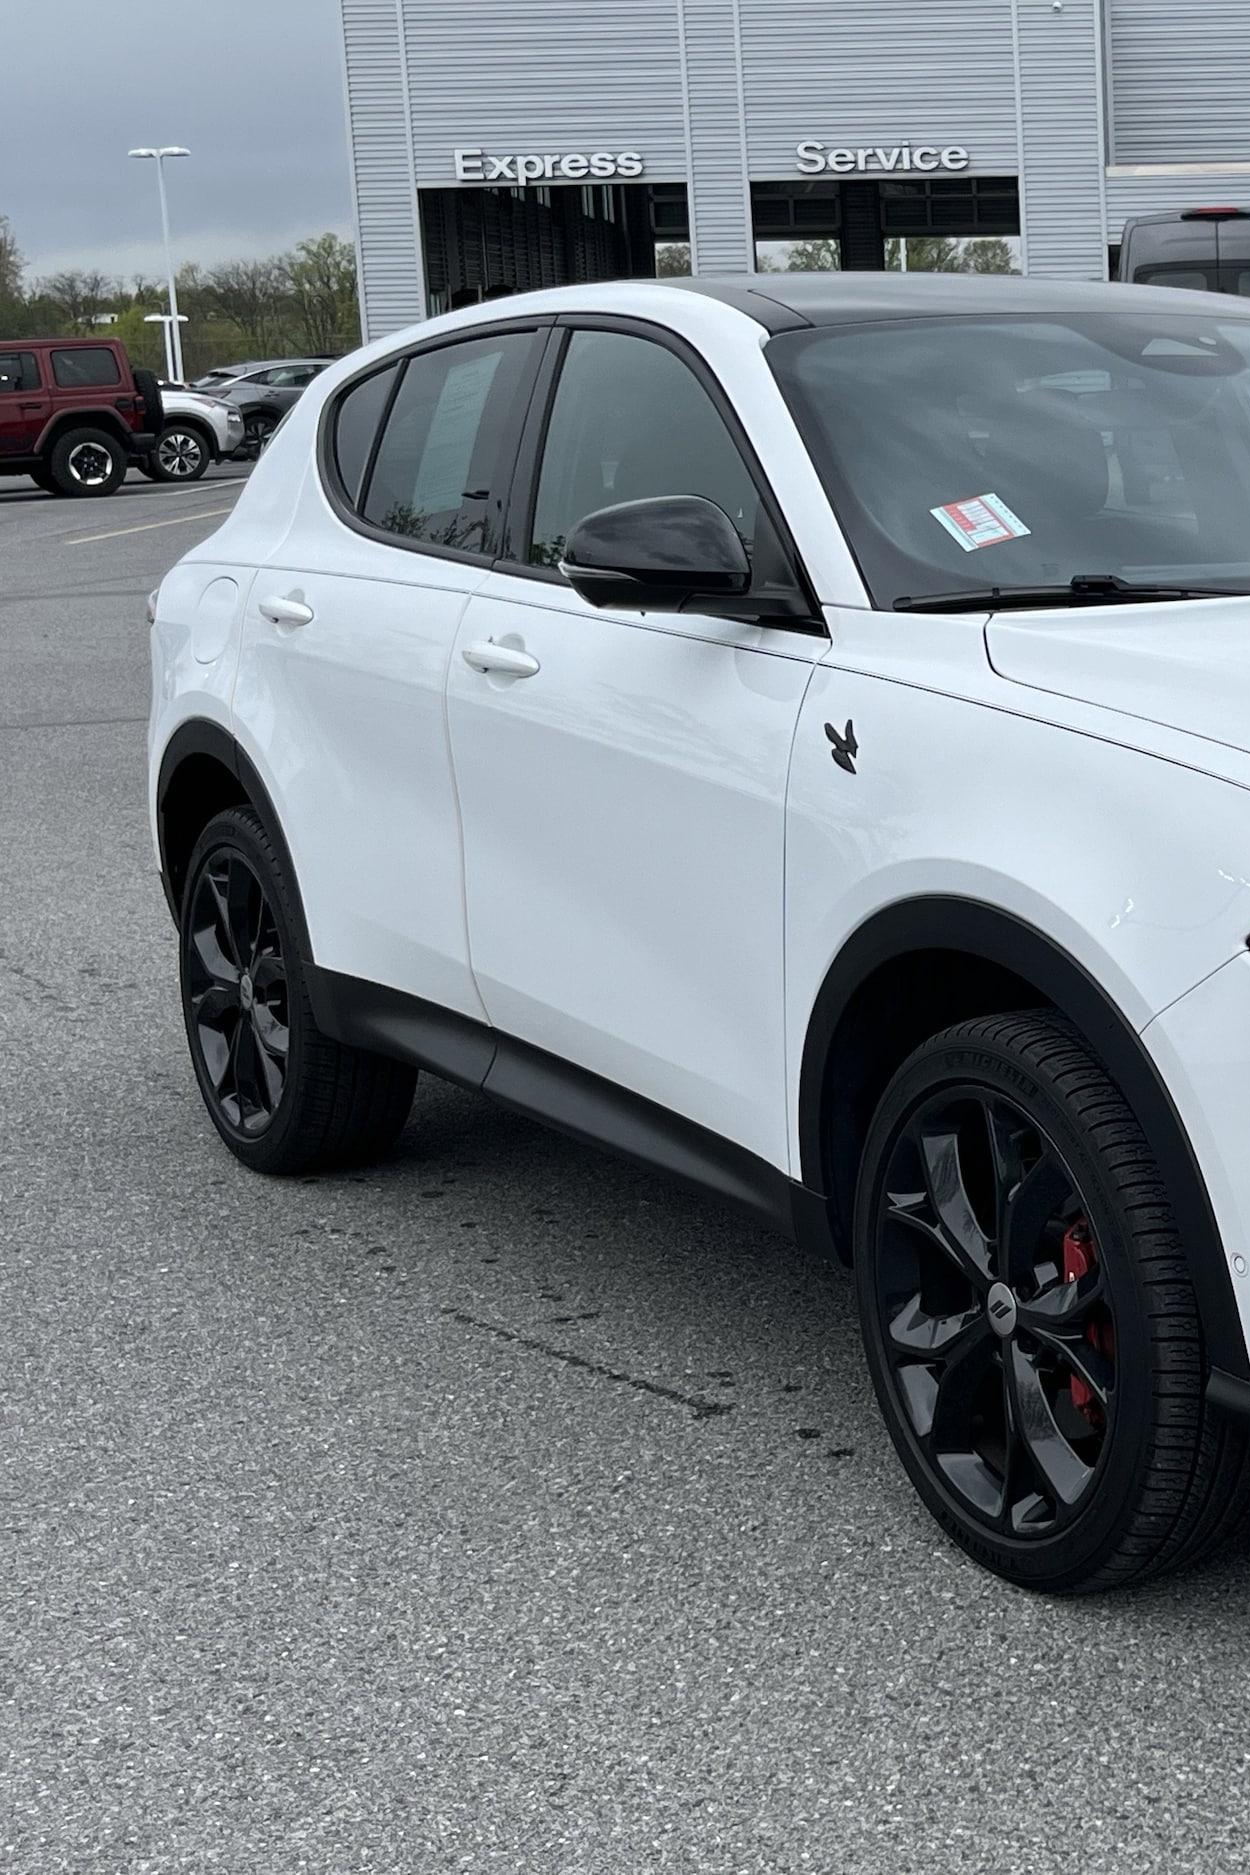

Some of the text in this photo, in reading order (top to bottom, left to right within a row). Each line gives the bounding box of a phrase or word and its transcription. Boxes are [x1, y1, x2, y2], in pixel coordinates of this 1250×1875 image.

[454, 149, 644, 187] Express
[796, 140, 969, 174] Service
[961, 1052, 1036, 1097] MICHELIN
